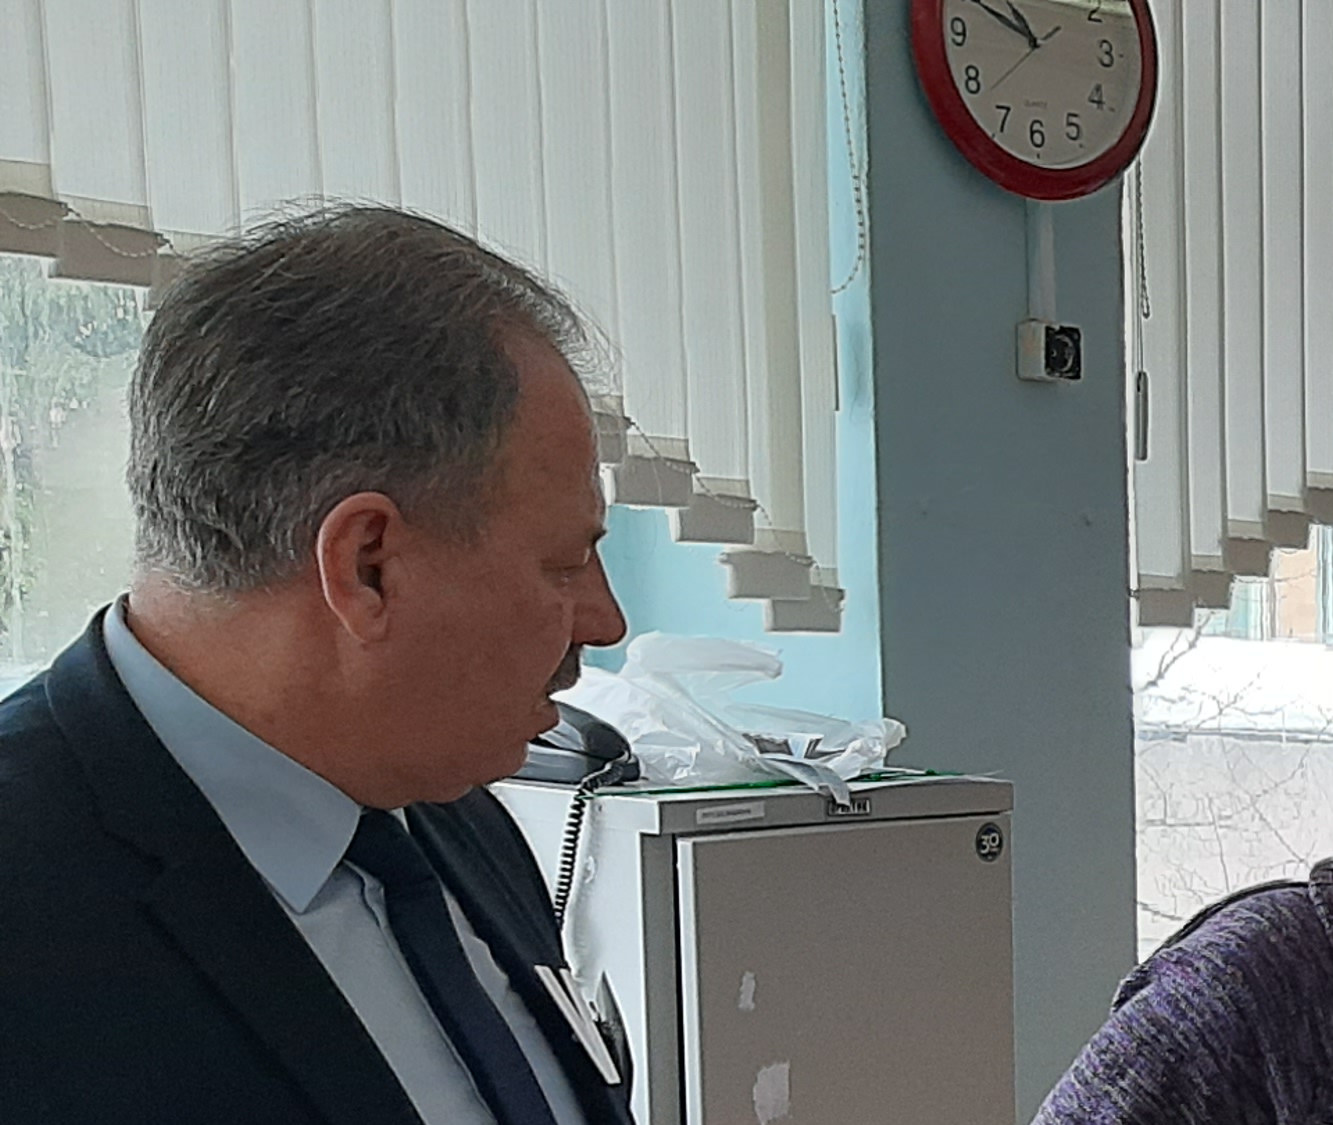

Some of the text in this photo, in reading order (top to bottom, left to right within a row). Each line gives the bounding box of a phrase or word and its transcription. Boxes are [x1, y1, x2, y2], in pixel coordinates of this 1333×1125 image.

[950, 16, 967, 47] 9
[1097, 39, 1115, 68] 3
[964, 64, 982, 95] 8
[1087, 83, 1106, 111] 4
[995, 104, 1012, 133] 7
[1065, 112, 1081, 141] 5
[1029, 119, 1046, 148] 6
[980, 832, 1000, 854] 30
